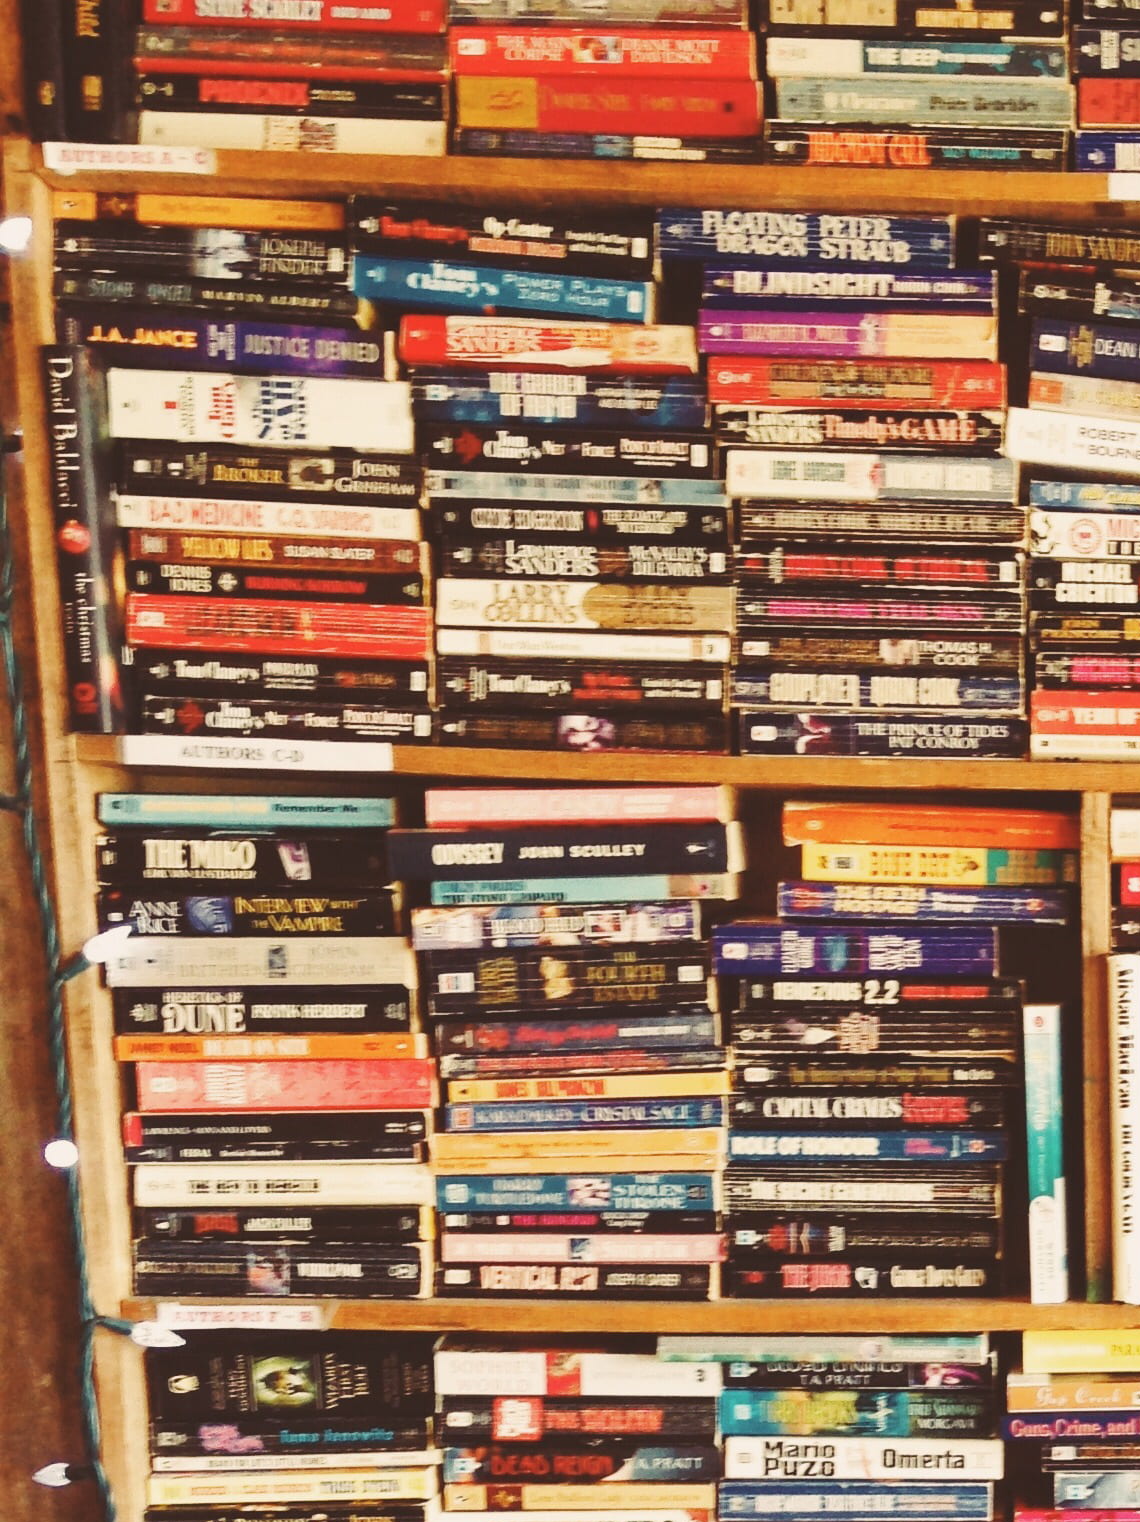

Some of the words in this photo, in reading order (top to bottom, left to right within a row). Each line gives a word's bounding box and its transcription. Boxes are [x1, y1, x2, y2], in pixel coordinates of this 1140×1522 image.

[819, 214, 889, 240] PETER
[819, 240, 910, 262] STRAUB
[134, 329, 197, 347] JANCE
[246, 335, 310, 358] JUSTICE
[129, 901, 181, 917] ANNE
[137, 917, 181, 933] RICE
[864, 979, 900, 1004] 2.2
[162, 1004, 245, 1032] DUNE
[765, 1441, 834, 1459] Mario
[883, 1449, 965, 1470] Omerta
[765, 1458, 834, 1476] Puzo
